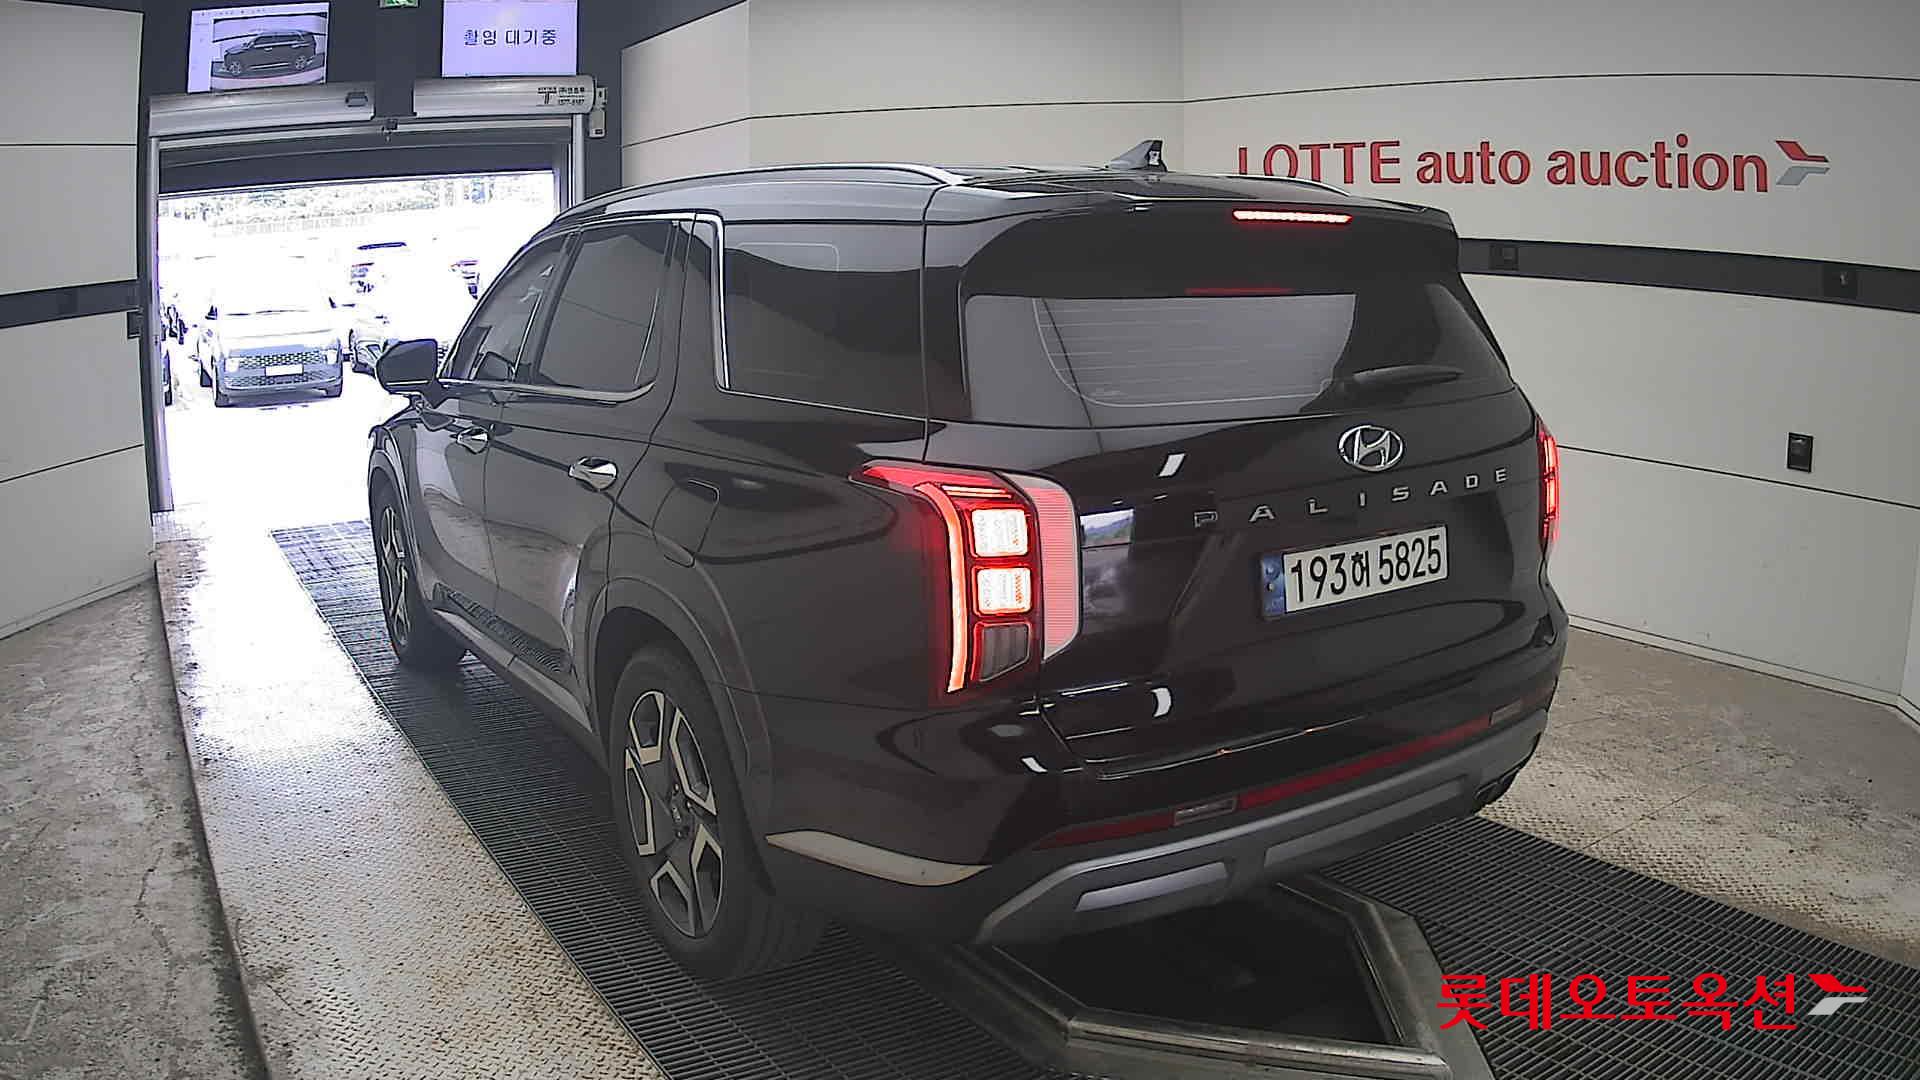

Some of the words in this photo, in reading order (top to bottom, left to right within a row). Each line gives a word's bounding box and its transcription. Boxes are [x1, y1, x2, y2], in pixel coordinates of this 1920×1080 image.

[504, 29, 557, 46] 대기중
[1416, 140, 1531, 186] auto
[1546, 133, 1769, 193] auction
[1194, 467, 1509, 529] PALISADE
[1378, 534, 1442, 586] 5825
